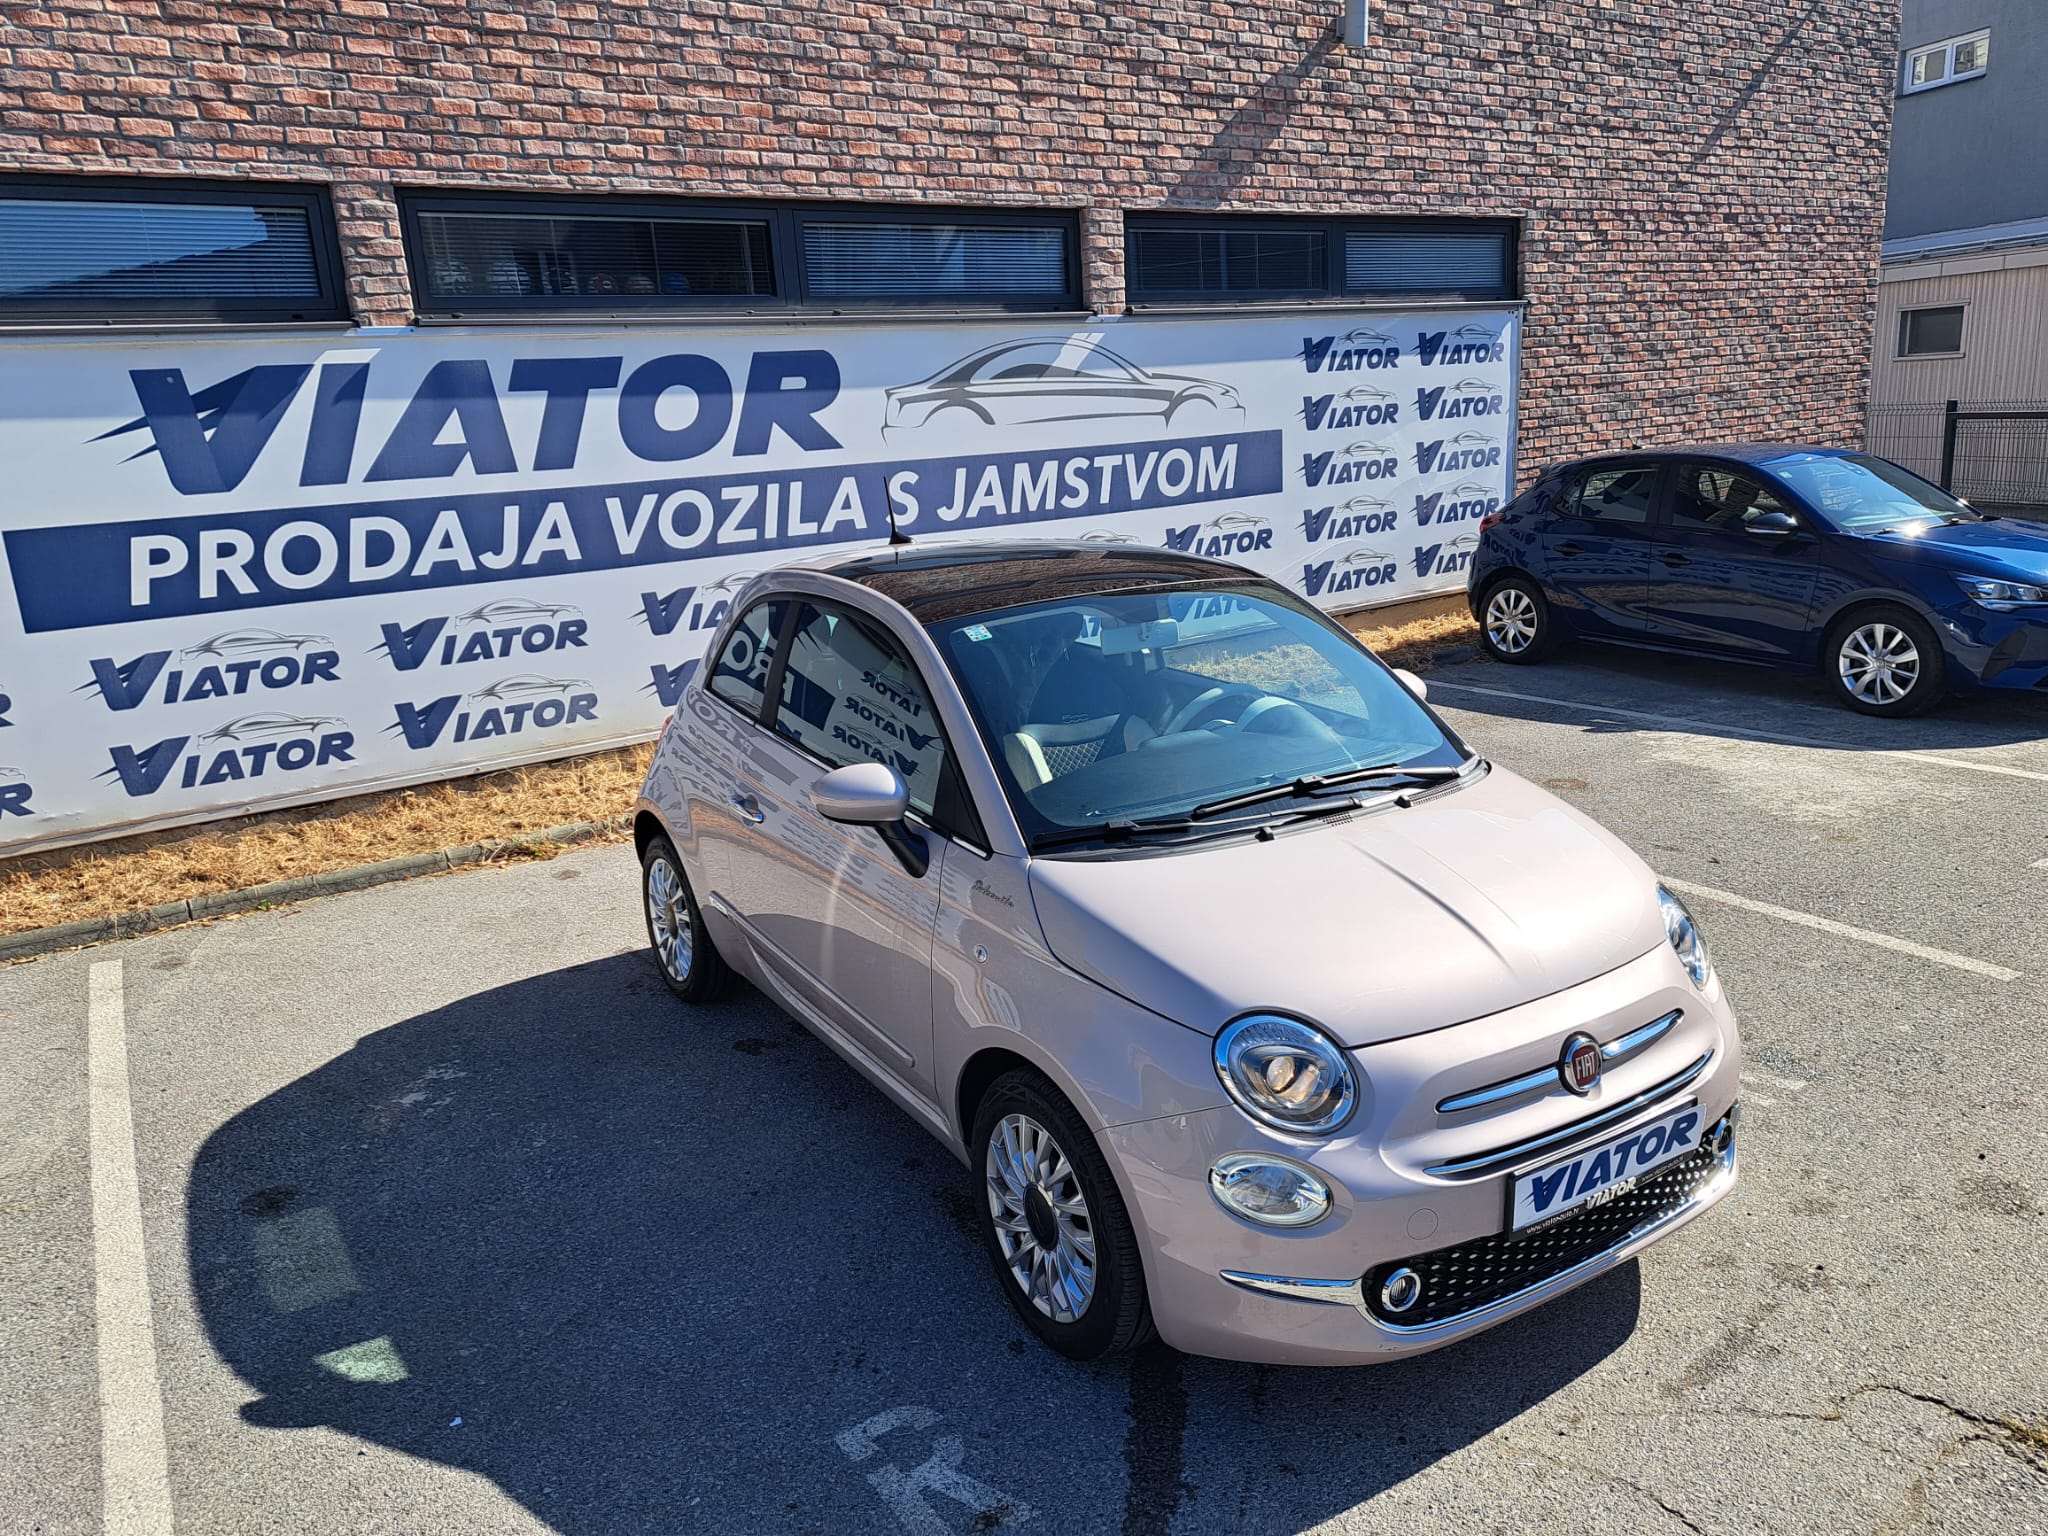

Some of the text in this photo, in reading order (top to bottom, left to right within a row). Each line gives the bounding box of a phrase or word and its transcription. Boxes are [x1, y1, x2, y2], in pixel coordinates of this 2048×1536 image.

[1296, 336, 1400, 373] VIATOR
[1411, 331, 1504, 366] VIATOR
[1297, 395, 1399, 431] VIATOR
[1410, 386, 1503, 420] VIATOR
[82, 347, 843, 496] VIATOR
[1296, 451, 1398, 487] VIATOR
[1411, 440, 1500, 473] VIATOR
[130, 443, 1239, 606] PRODAJA VOZILA S JAMSTVOM
[1296, 506, 1397, 542] VIATOR
[1408, 492, 1499, 526] VIATOR
[1160, 523, 1273, 557] VIATOR
[1298, 560, 1397, 596] VIATOR
[1407, 543, 1471, 577] VIAT
[627, 586, 730, 637] VIA
[365, 616, 588, 671] VIATOR
[71, 649, 341, 711] VIATOR
[379, 692, 599, 749] VIATOR
[90, 731, 356, 797] VIATOR
[1575, 1051, 1596, 1080] FIAT
[1520, 1111, 1698, 1213] VIATOR
[1586, 1176, 1636, 1209] VIATOR
